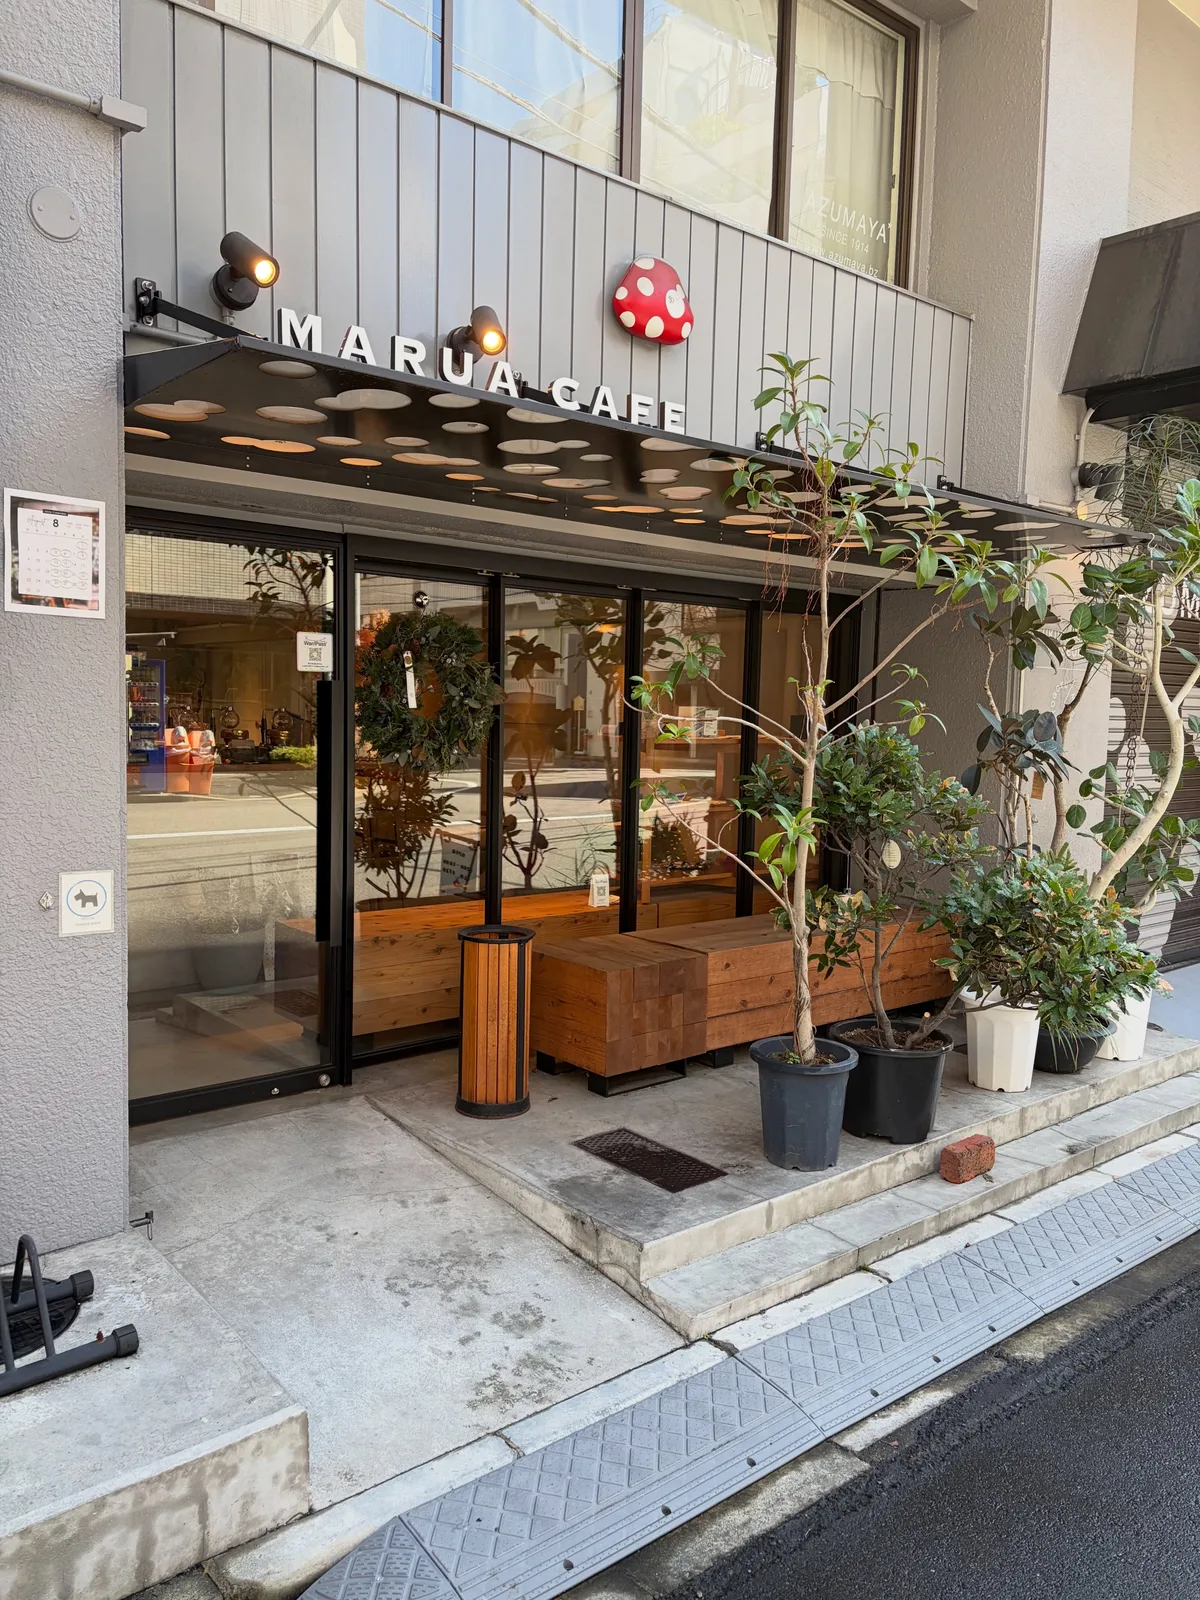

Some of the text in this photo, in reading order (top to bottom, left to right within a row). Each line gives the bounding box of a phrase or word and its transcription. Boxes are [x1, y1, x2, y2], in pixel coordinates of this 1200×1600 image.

[805, 192, 887, 244] AZUMAYA
[821, 225, 869, 254] SINCE 1914
[278, 307, 686, 435] MARUA CAFE
[53, 519, 59, 527] 8
